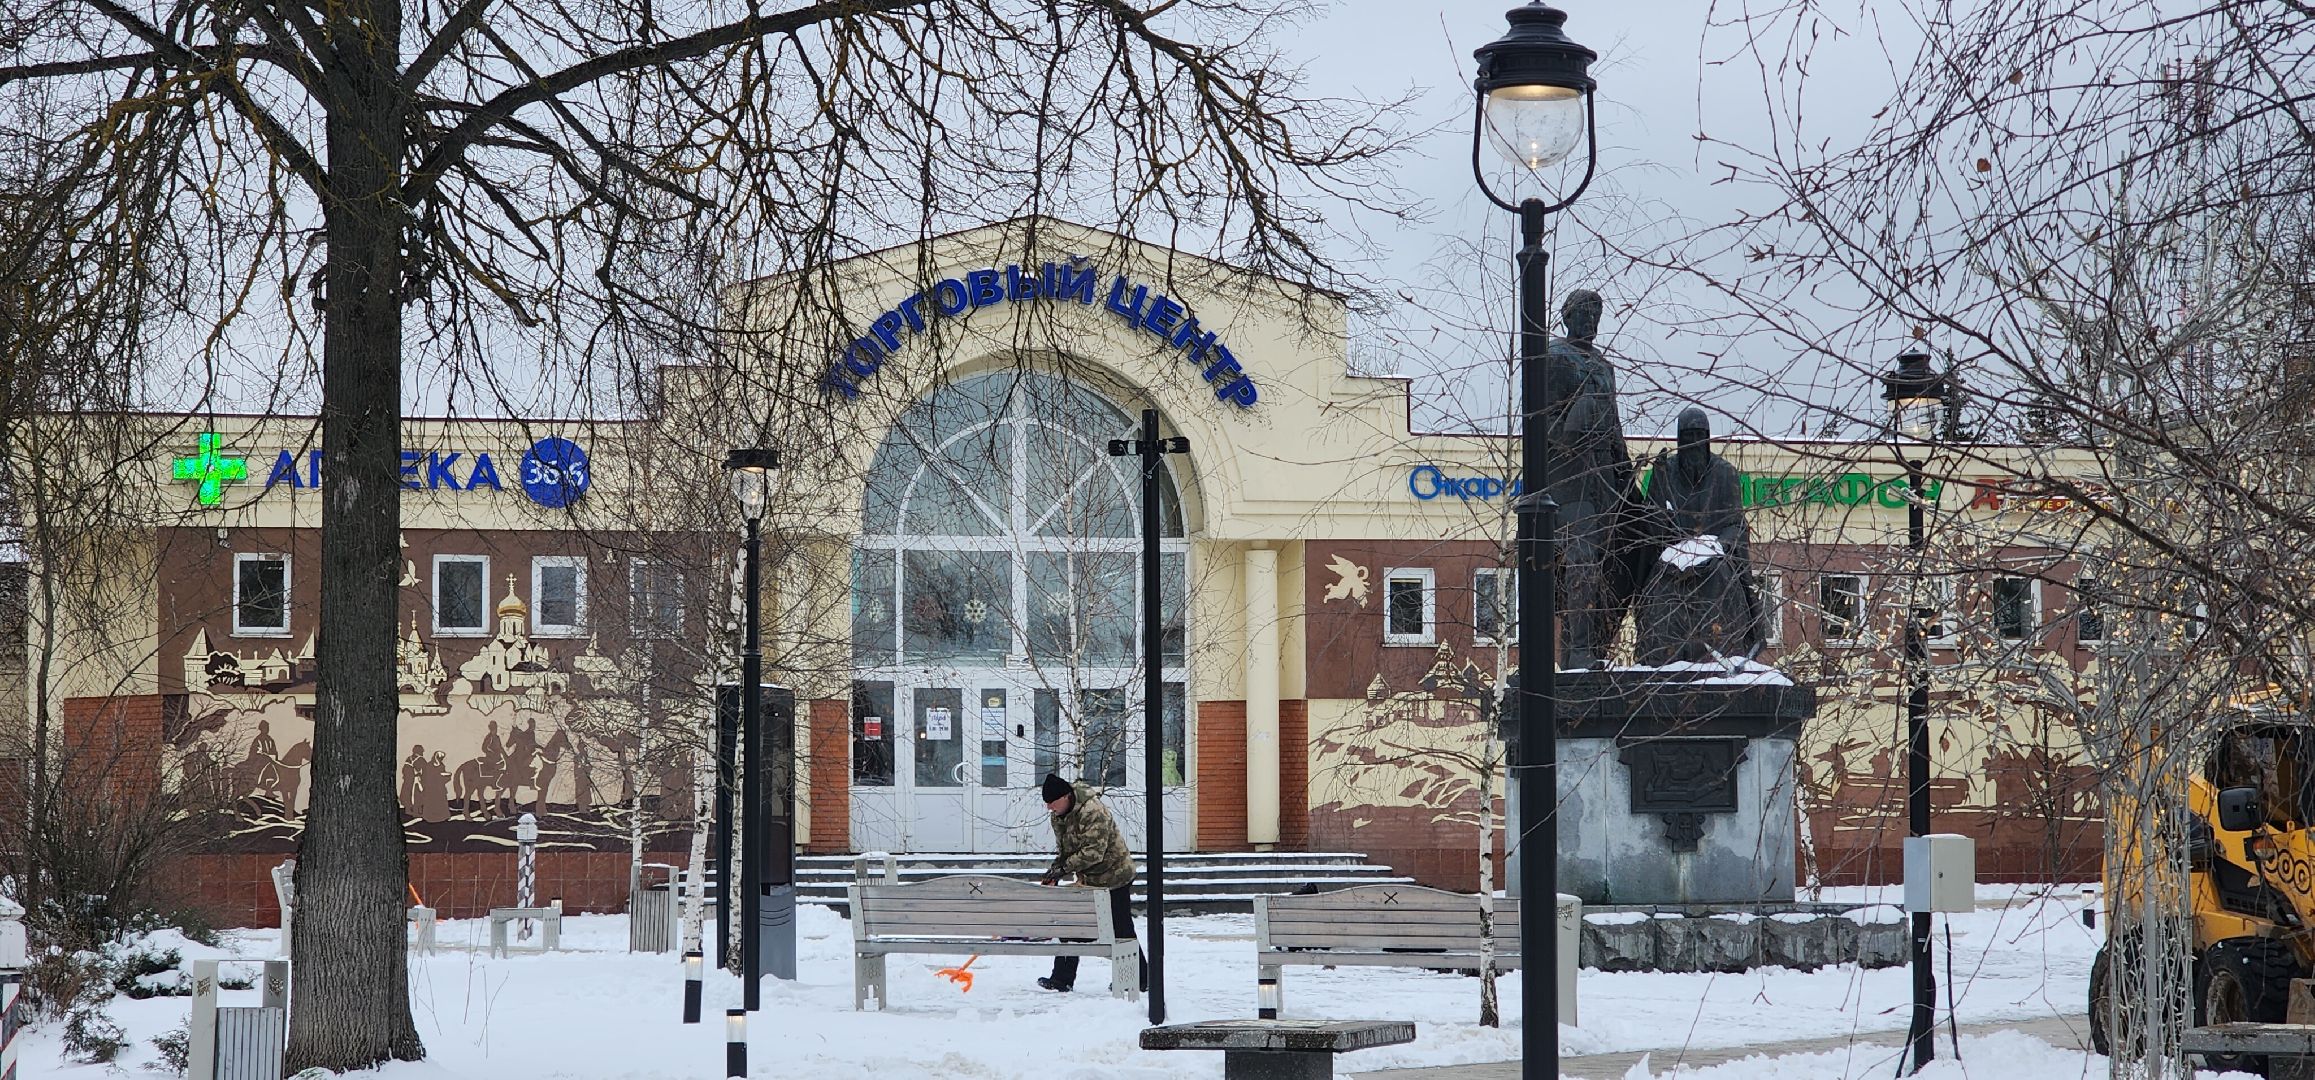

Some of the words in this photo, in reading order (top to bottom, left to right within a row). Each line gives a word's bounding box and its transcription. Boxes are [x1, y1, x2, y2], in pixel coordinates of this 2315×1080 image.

[820, 255, 1097, 400] ТОРГОВЫЙ
[1105, 275, 1258, 409] ЦЕНТР
[266, 449, 502, 491] АЕКА
[1409, 465, 1523, 500] Очкари
